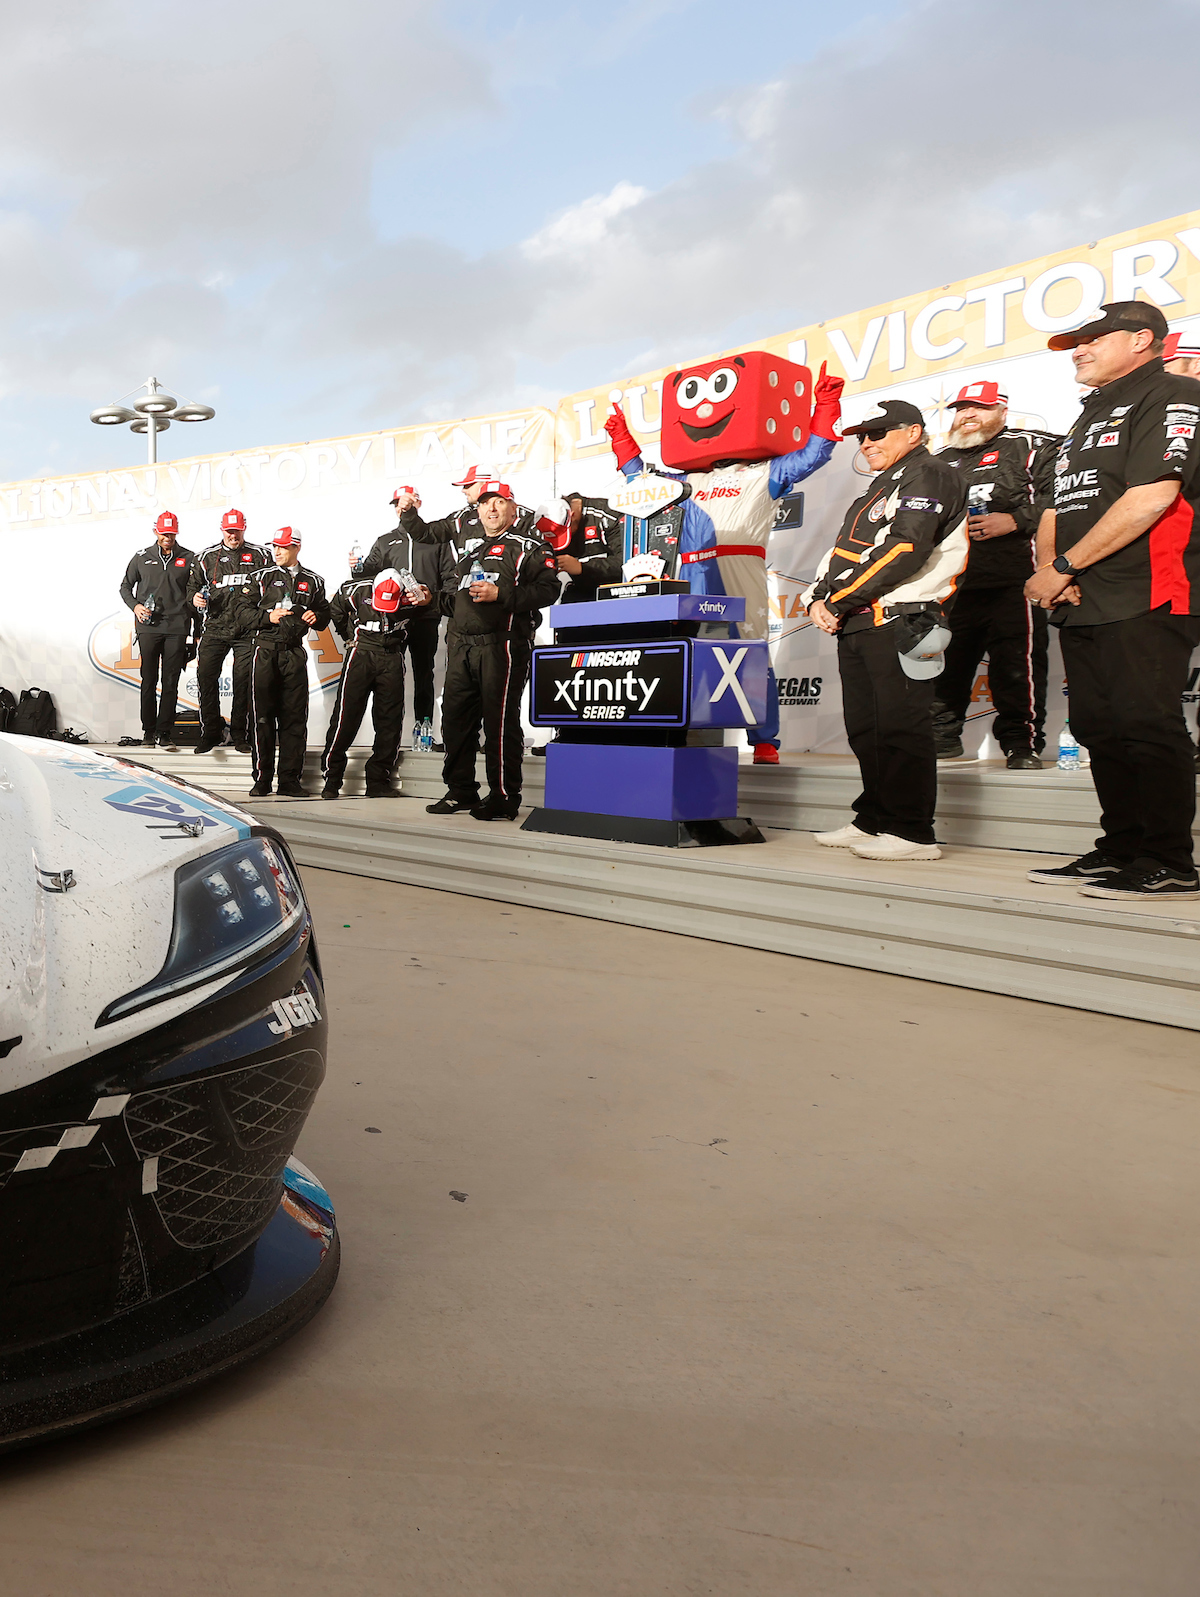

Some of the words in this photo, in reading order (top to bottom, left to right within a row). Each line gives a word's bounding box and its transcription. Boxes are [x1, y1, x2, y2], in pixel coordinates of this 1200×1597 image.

[1171, 426, 1191, 436] 3M
[1100, 435, 1116, 444] 3M
[167, 437, 374, 504] VICTORY
[382, 417, 527, 479] LANE
[611, 585, 647, 597] WINNER
[698, 601, 727, 615] xfinity
[587, 650, 641, 667] NASCAR
[554, 670, 661, 711] xfinity
[776, 677, 823, 697] EGAS
[779, 698, 820, 706] EEDWAY
[582, 706, 626, 719] SERIES
[267, 992, 322, 1035] JGR
